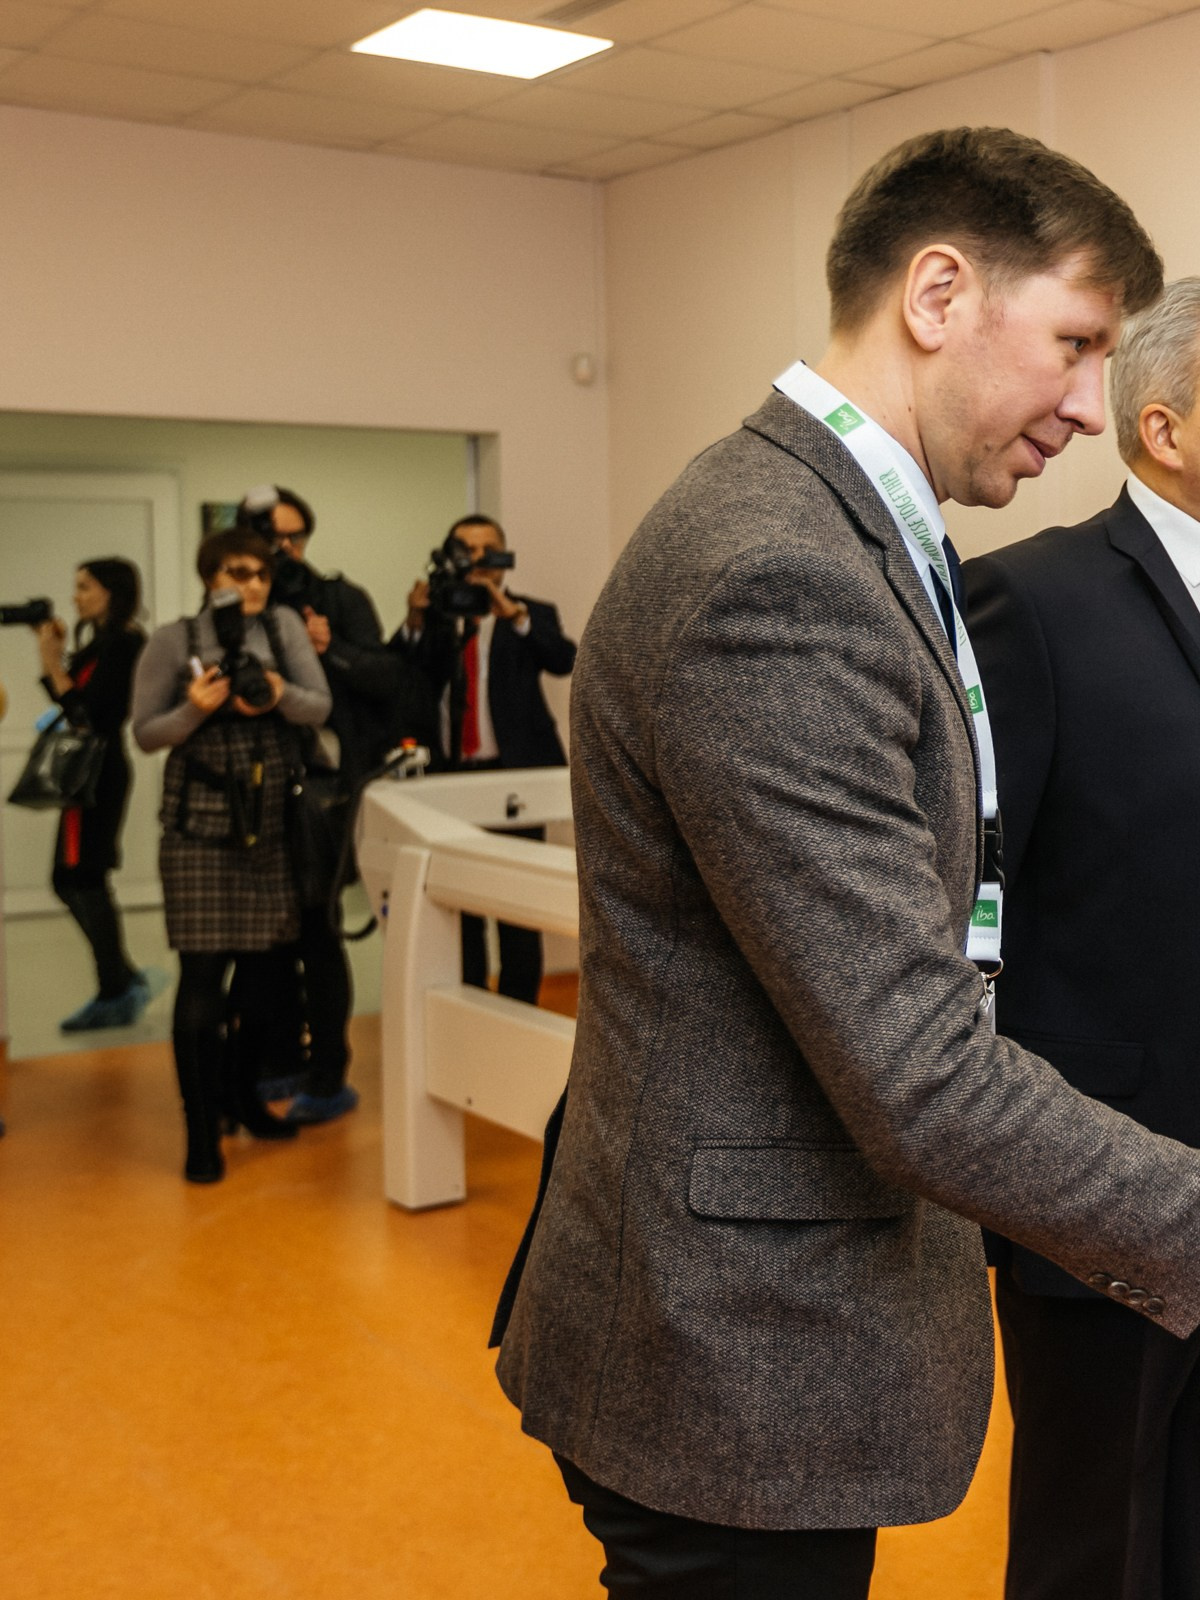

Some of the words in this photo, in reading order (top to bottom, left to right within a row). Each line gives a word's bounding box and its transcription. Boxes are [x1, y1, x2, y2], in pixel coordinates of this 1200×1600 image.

[879, 467, 918, 522] TOGETHER
[907, 517, 943, 562] PROMISE
[975, 904, 996, 922] iba
